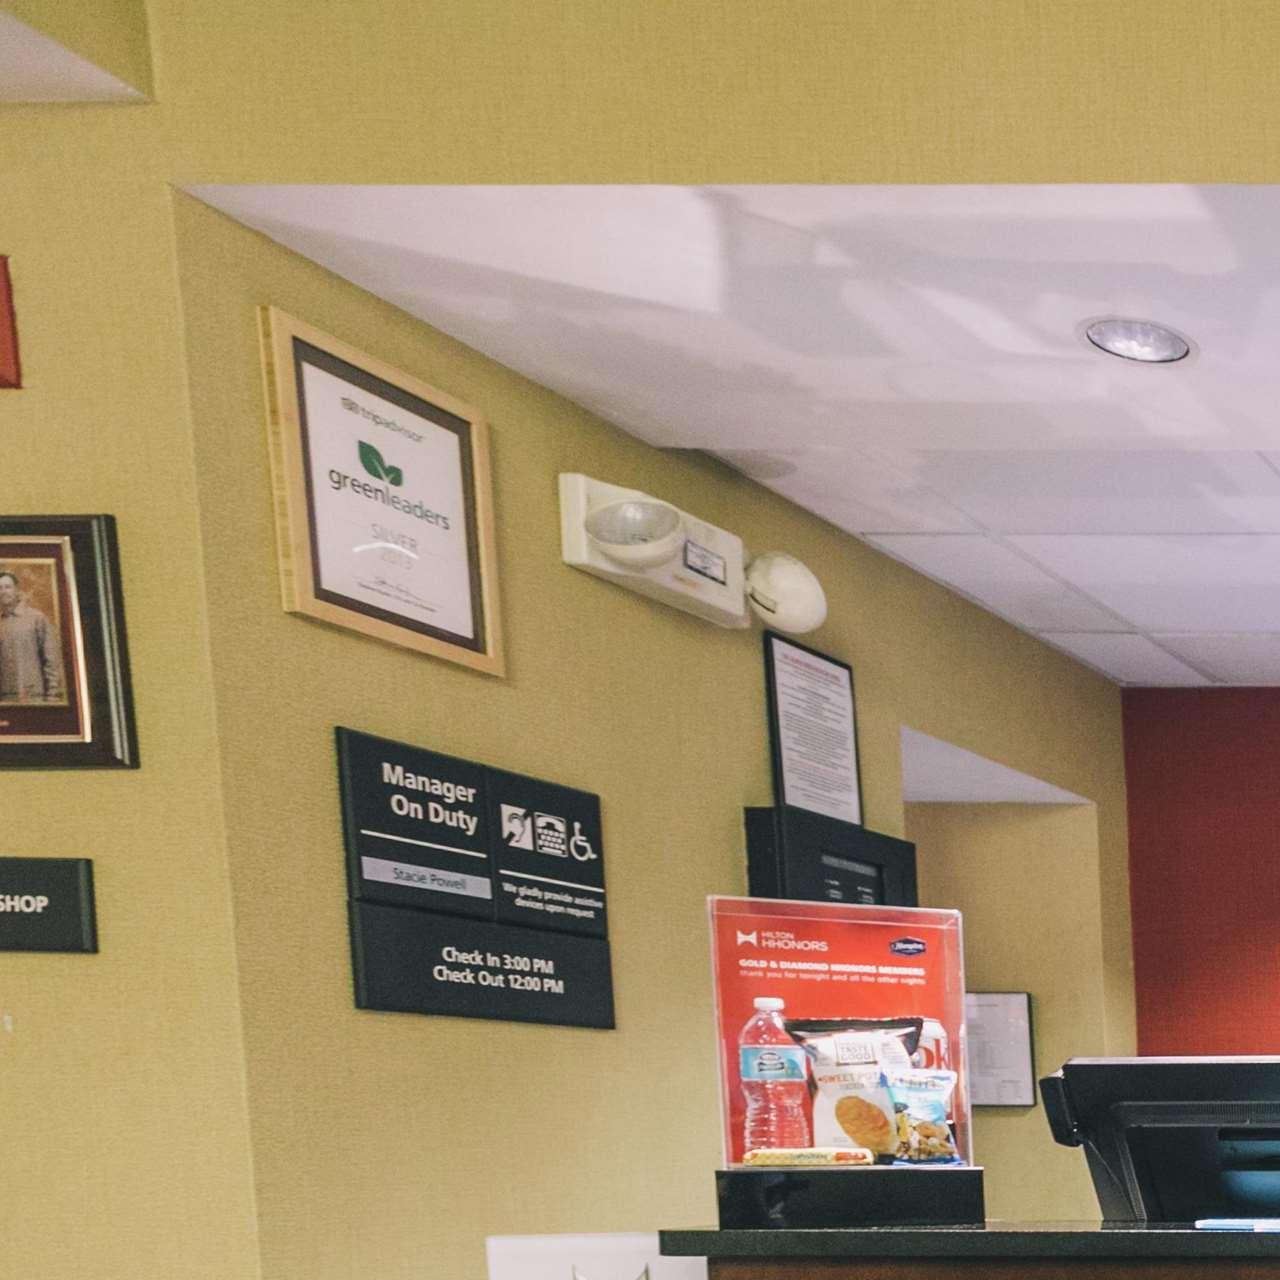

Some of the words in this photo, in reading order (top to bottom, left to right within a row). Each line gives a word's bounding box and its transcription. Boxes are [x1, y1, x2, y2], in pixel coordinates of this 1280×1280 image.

[328, 468, 450, 531] greenleaders
[381, 761, 477, 804] Manager
[390, 794, 424, 820] On
[428, 801, 478, 836] Duty
[761, 931, 794, 940] HILTON
[761, 940, 829, 952] HHONORS
[442, 946, 484, 966] Check
[486, 952, 500, 968] In
[502, 954, 531, 972] 3:00
[533, 958, 555, 975] PM
[738, 959, 768, 969] GOLD
[769, 960, 778, 969] &
[779, 961, 829, 972] DIAMOND
[433, 965, 476, 985] Check
[478, 970, 506, 988] Out
[508, 973, 541, 992] 12:00
[543, 978, 565, 994] PM
[831, 974, 848, 982] and
